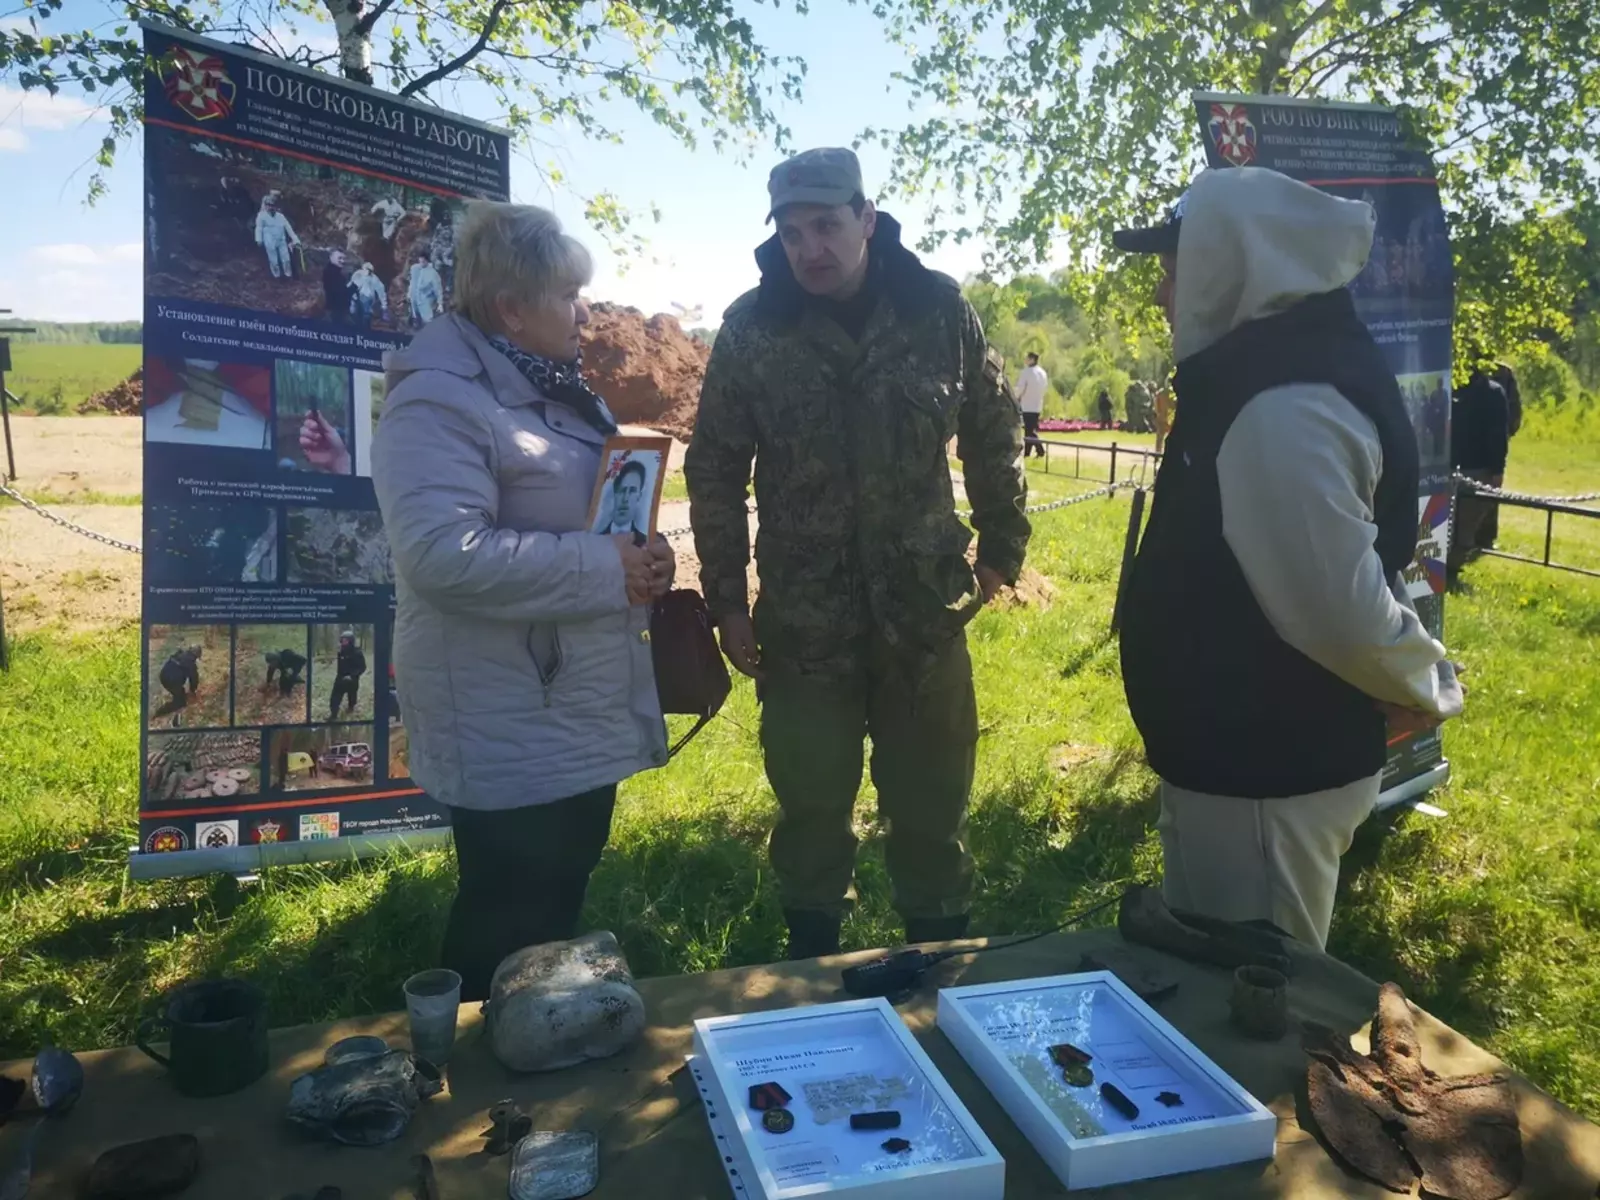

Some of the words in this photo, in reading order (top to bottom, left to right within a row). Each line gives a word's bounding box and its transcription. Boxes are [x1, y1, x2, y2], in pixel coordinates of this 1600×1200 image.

[245, 67, 405, 133] ПОИСКОВАЯ
[413, 116, 500, 160] РАБОТА
[1261, 108, 1294, 126] РОО
[1299, 110, 1323, 127] ПО
[1326, 112, 1360, 130] ВПК
[157, 305, 236, 327] Установление
[238, 319, 265, 332] имён
[268, 324, 318, 340] погибших
[320, 333, 354, 345] солдат
[356, 334, 396, 350] Красной
[182, 331, 240, 347] Солдатские
[243, 341, 294, 354] медальоны
[296, 348, 339, 361] помогают
[177, 477, 209, 486] Работа
[217, 481, 259, 489] немецкой
[243, 489, 262, 497] GPS
[775, 1053, 802, 1061] Иван
[803, 1046, 854, 1057] Павлович
